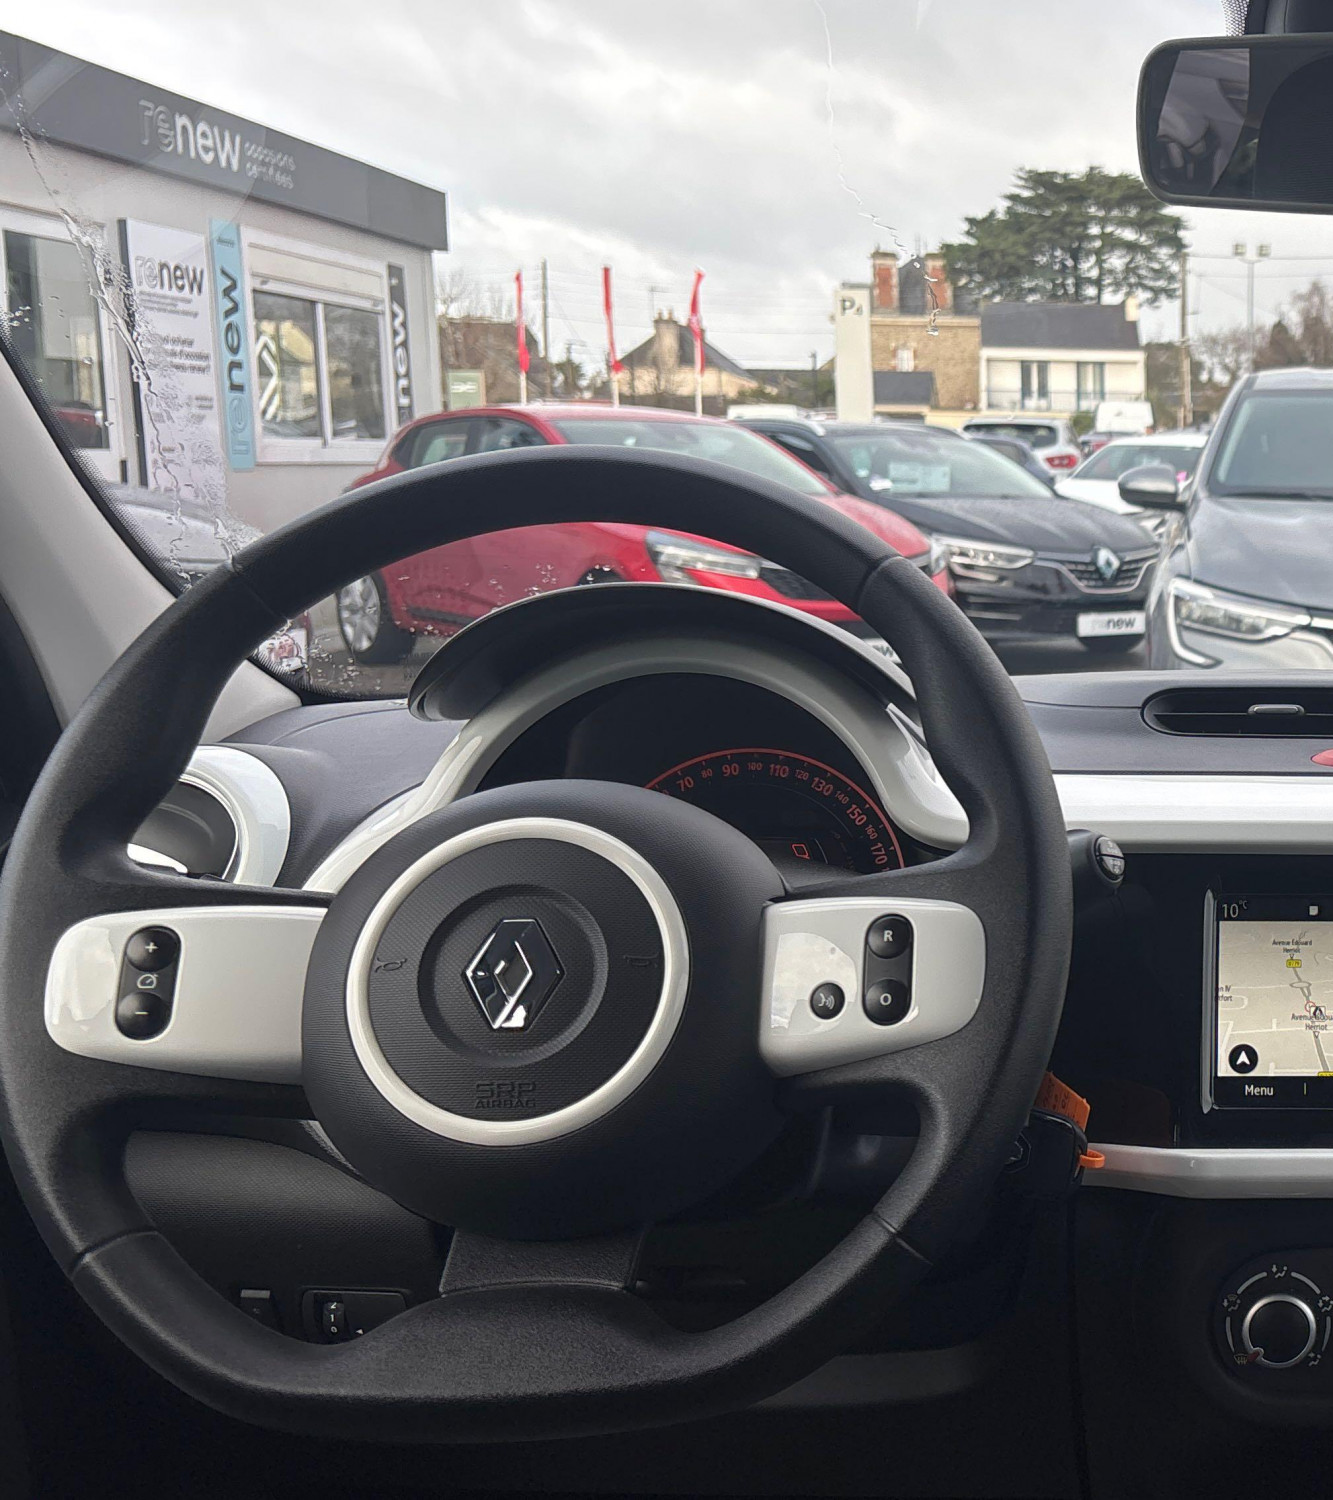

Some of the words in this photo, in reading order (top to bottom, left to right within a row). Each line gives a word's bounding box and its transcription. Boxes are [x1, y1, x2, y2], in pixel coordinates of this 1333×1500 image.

[138, 99, 241, 172] renew
[134, 255, 204, 296] renew
[219, 265, 250, 455] renew
[701, 768, 713, 779] 80
[722, 763, 739, 776] 90
[747, 762, 763, 771] 100
[769, 763, 789, 778] 110
[795, 769, 809, 780] 120
[676, 776, 694, 792] 70
[811, 777, 834, 796] 130
[835, 790, 850, 804] 140
[846, 804, 867, 826] 150
[865, 825, 878, 840] 160
[870, 842, 888, 865] 170
[883, 930, 893, 942] R
[475, 1081, 537, 1098] SRP
[1244, 1084, 1274, 1096] Menu
[475, 1099, 537, 1109] AIRBAG
[330, 1301, 338, 1309] 2
[330, 1314, 335, 1322] 1
